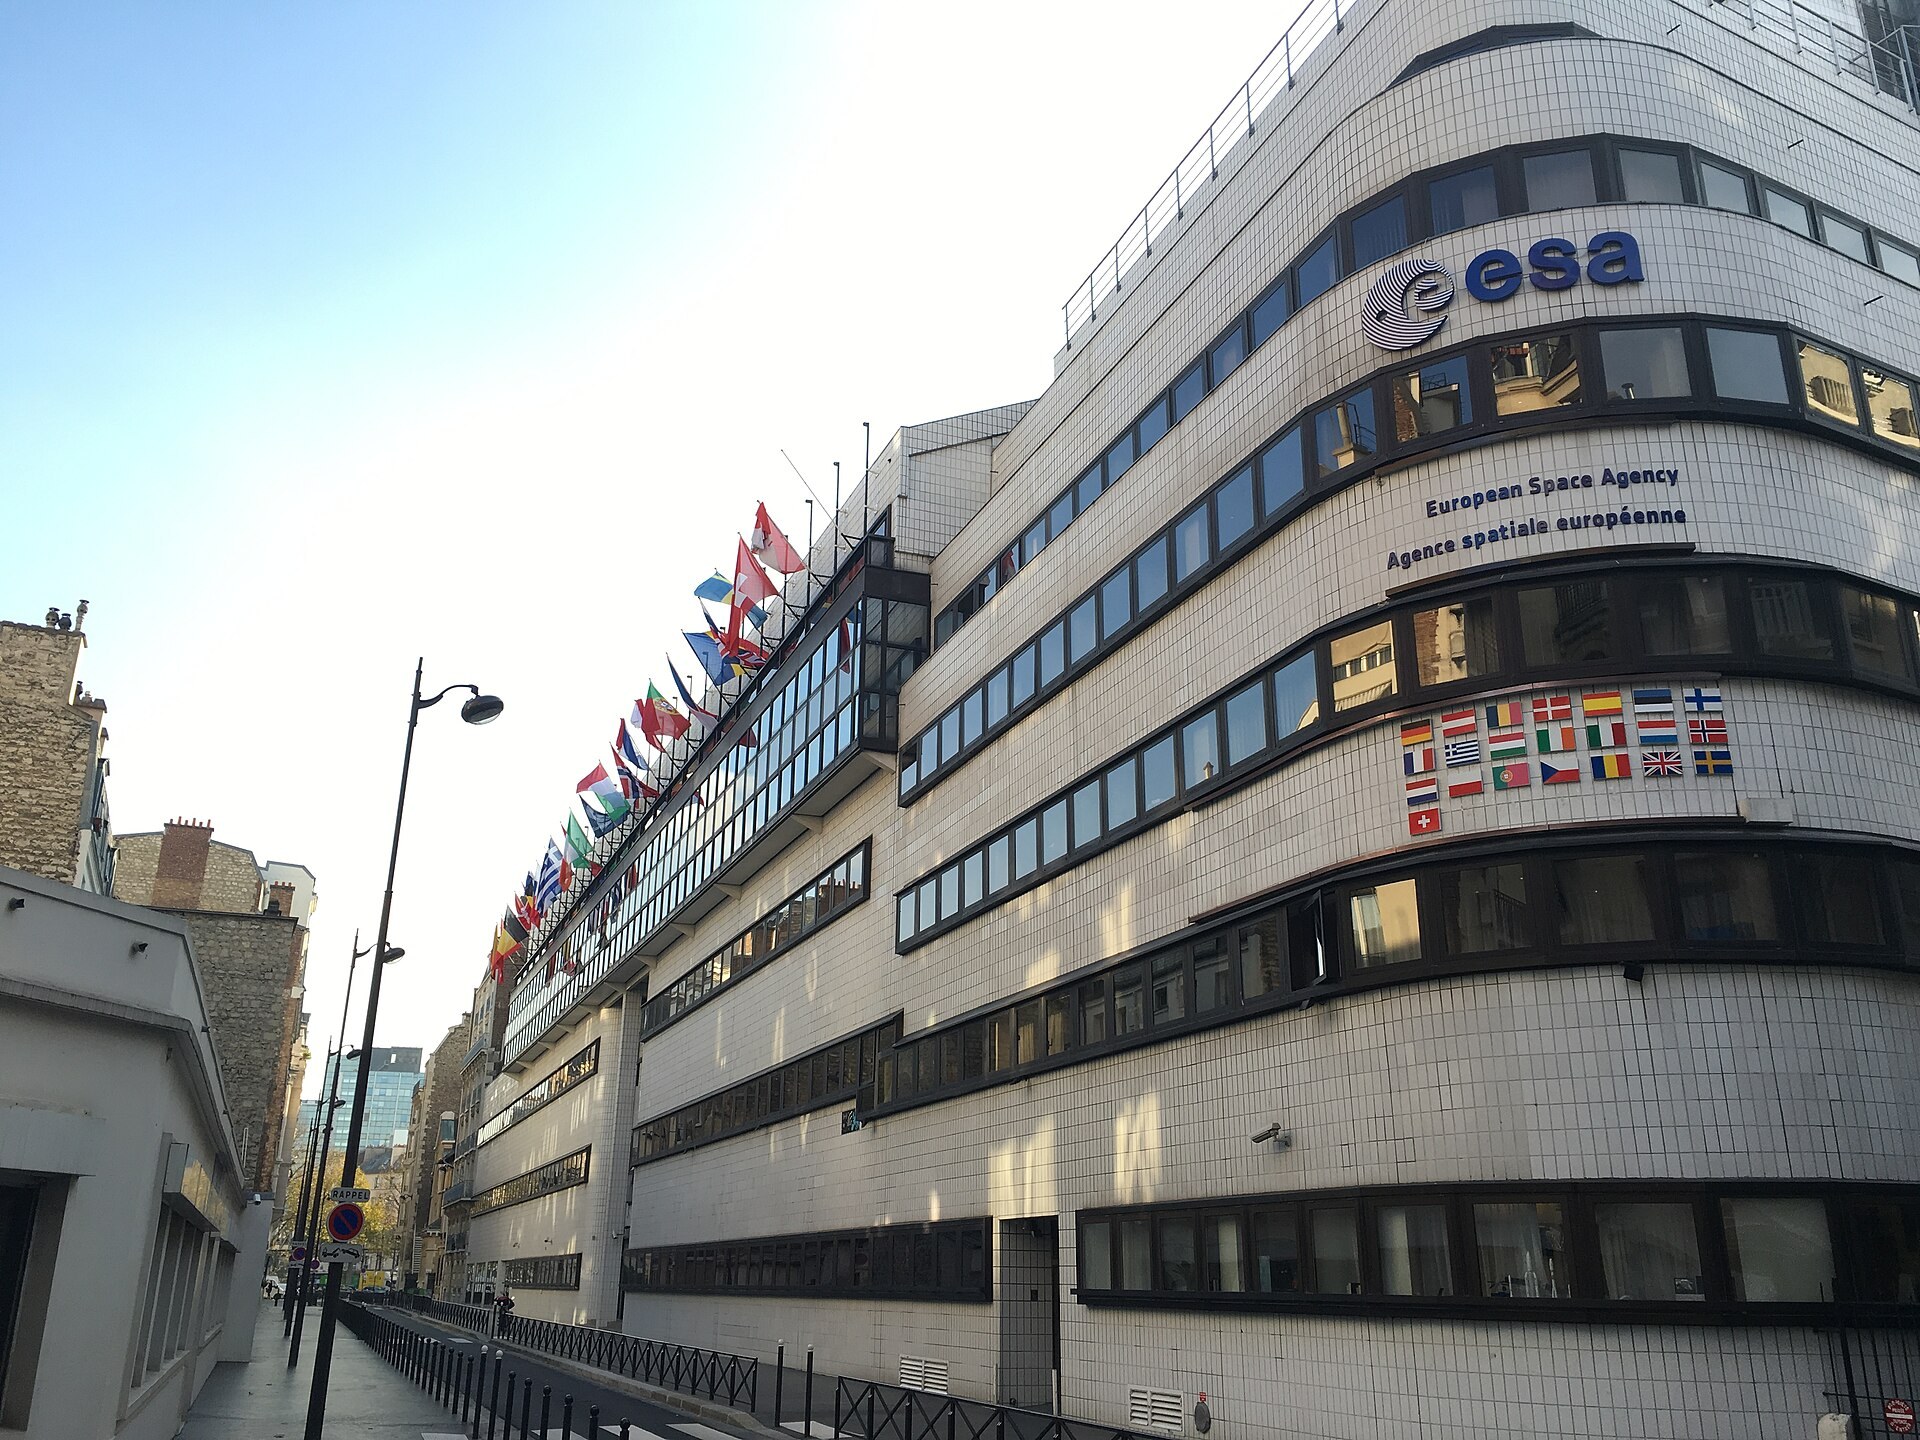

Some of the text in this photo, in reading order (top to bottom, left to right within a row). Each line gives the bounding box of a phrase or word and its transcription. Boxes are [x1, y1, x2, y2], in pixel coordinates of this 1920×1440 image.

[1465, 231, 1645, 302] esa
[1426, 467, 1679, 518] European Space Agency
[1387, 506, 1687, 570] Agence spatiale européenne
[332, 1190, 369, 1200] RAPPEL
